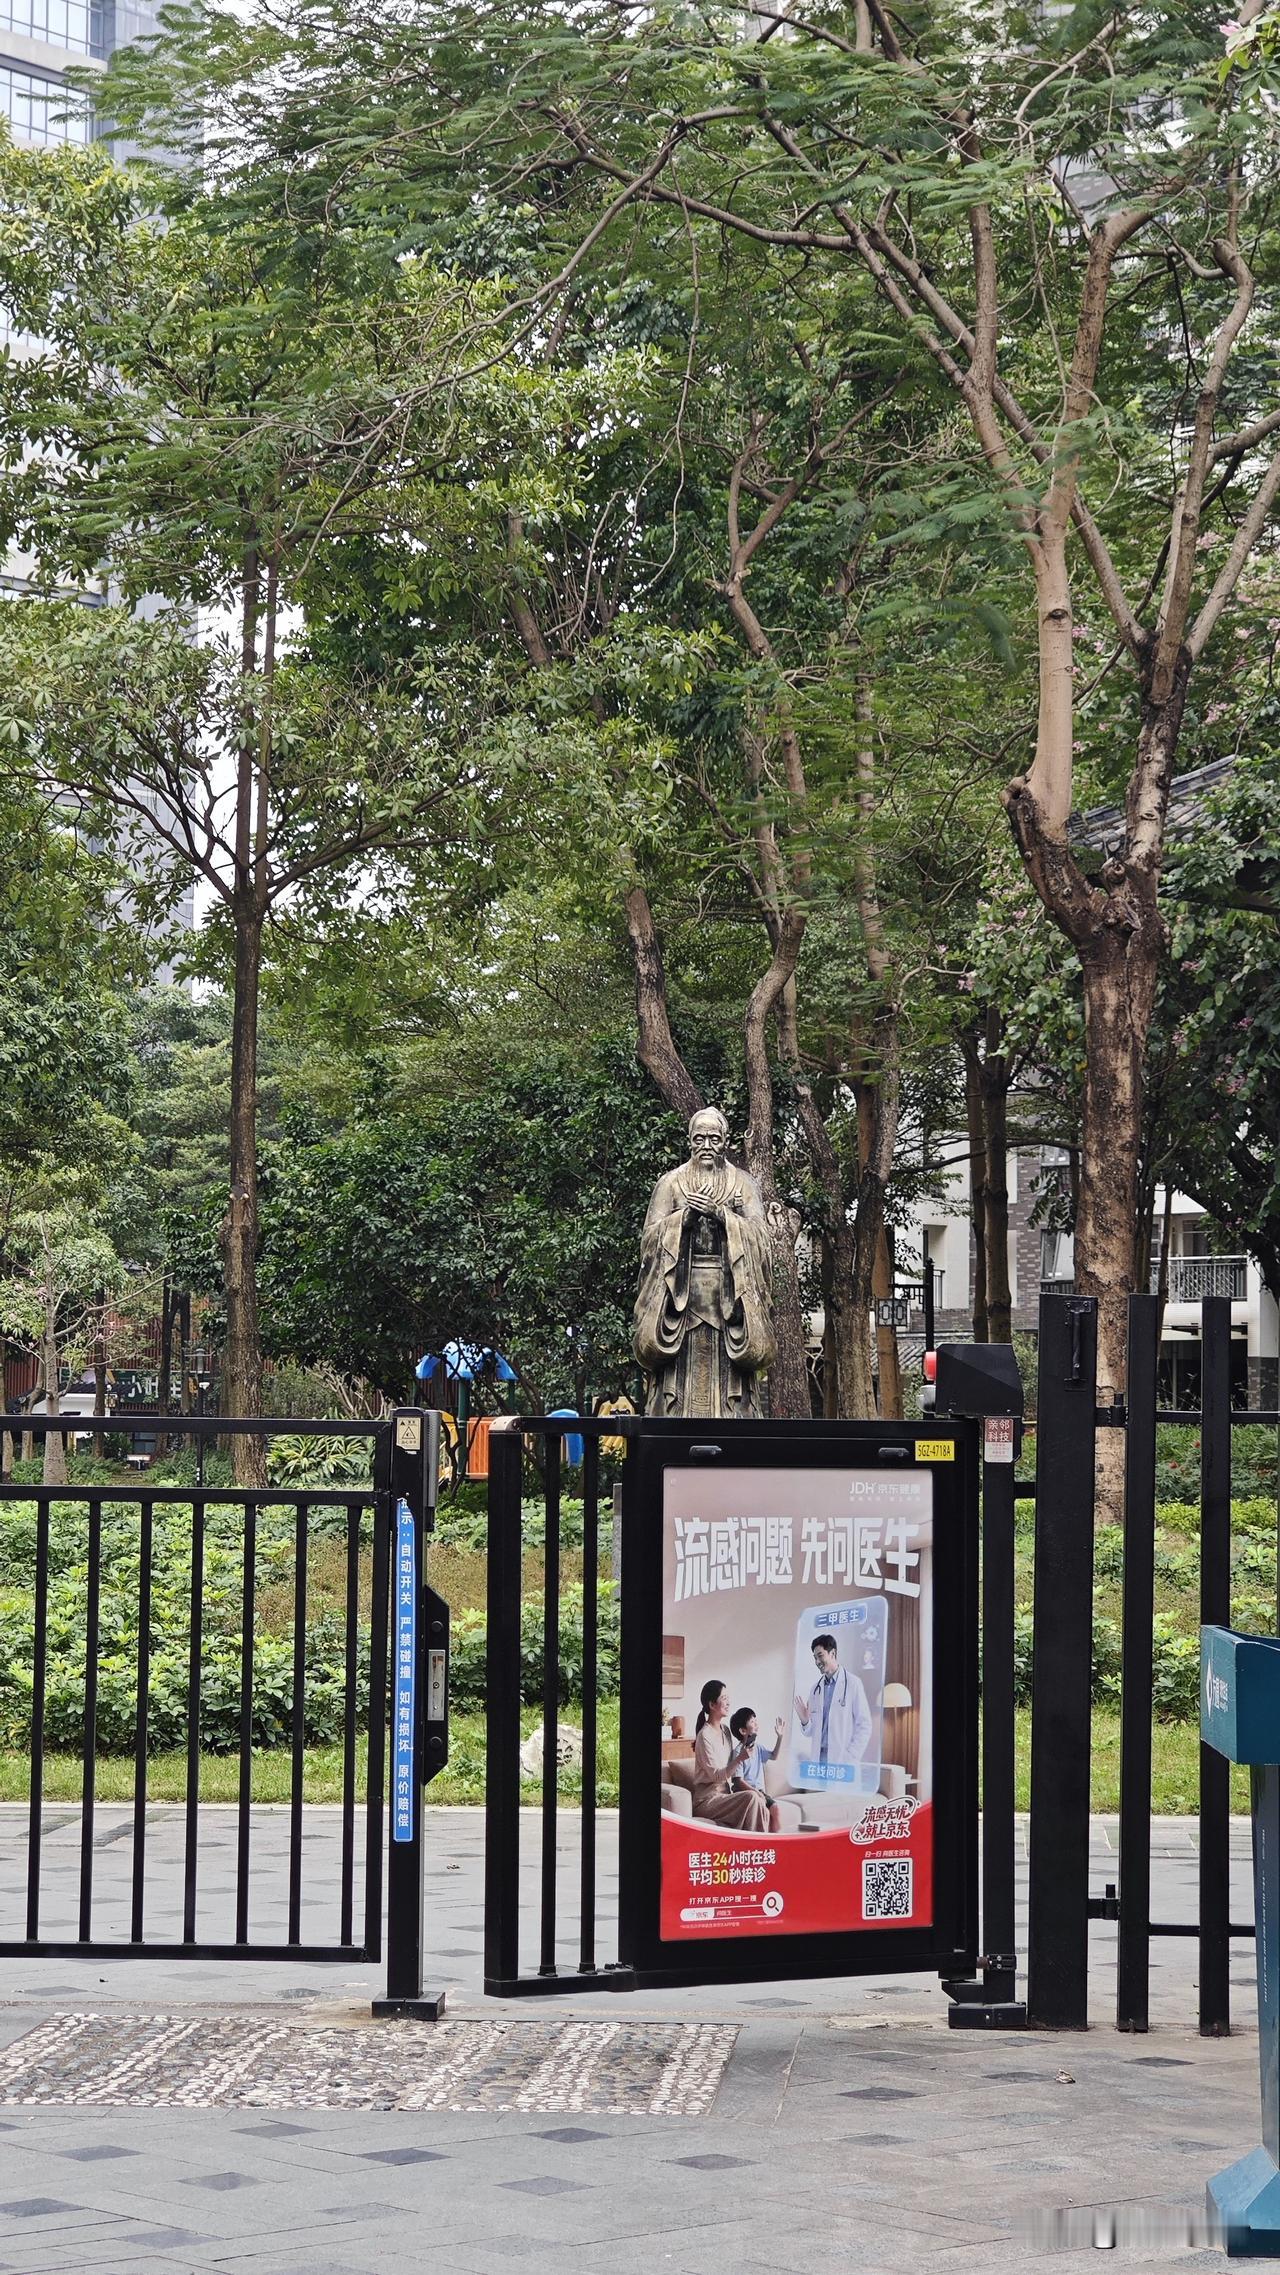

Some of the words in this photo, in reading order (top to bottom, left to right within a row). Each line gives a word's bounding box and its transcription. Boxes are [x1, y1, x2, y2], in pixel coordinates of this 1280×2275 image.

[988, 1431, 1010, 1442] 科技
[674, 1517, 792, 1601] 流感问题
[801, 1517, 920, 1598] 先问医生
[817, 1609, 860, 1627] 三甲医生
[399, 1616, 412, 1679] 严禁碰撞
[398, 1691, 411, 1753] 如有损坏
[807, 1764, 846, 1779] 在线问诊
[398, 1764, 410, 1828] 原价赔偿
[861, 1804, 911, 1824] 流感无忧
[862, 1820, 910, 1839] 就上京东
[688, 1848, 776, 1868] 医生24小时在线
[688, 1866, 767, 1887] 平均30秒接诊
